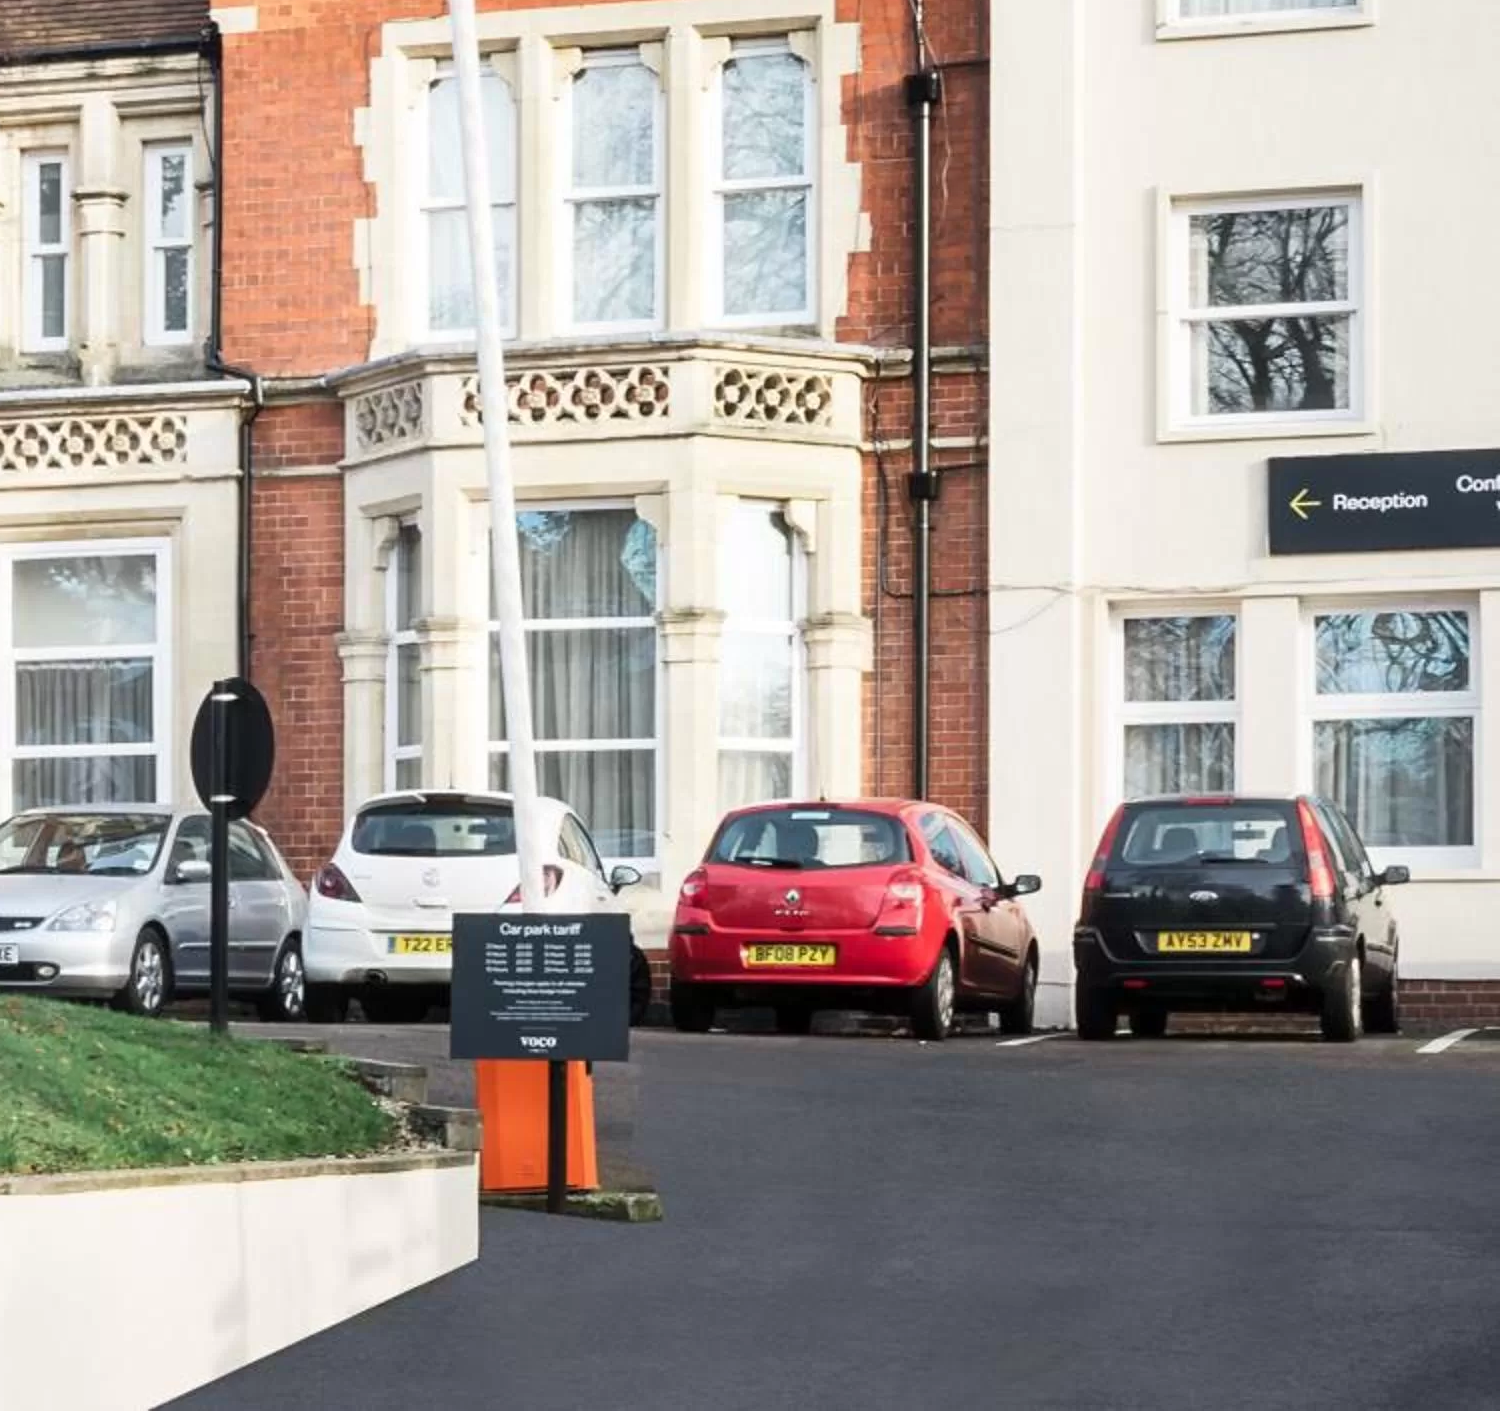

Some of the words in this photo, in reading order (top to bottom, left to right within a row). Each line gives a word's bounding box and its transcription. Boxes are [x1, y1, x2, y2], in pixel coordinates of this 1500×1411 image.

[1333, 492, 1428, 513] Reception
[500, 922, 521, 935] Car
[524, 922, 551, 938] park
[553, 922, 583, 935] tariff
[403, 938, 431, 951] T22
[1166, 933, 1207, 948] AY53
[799, 946, 829, 961] PZY
